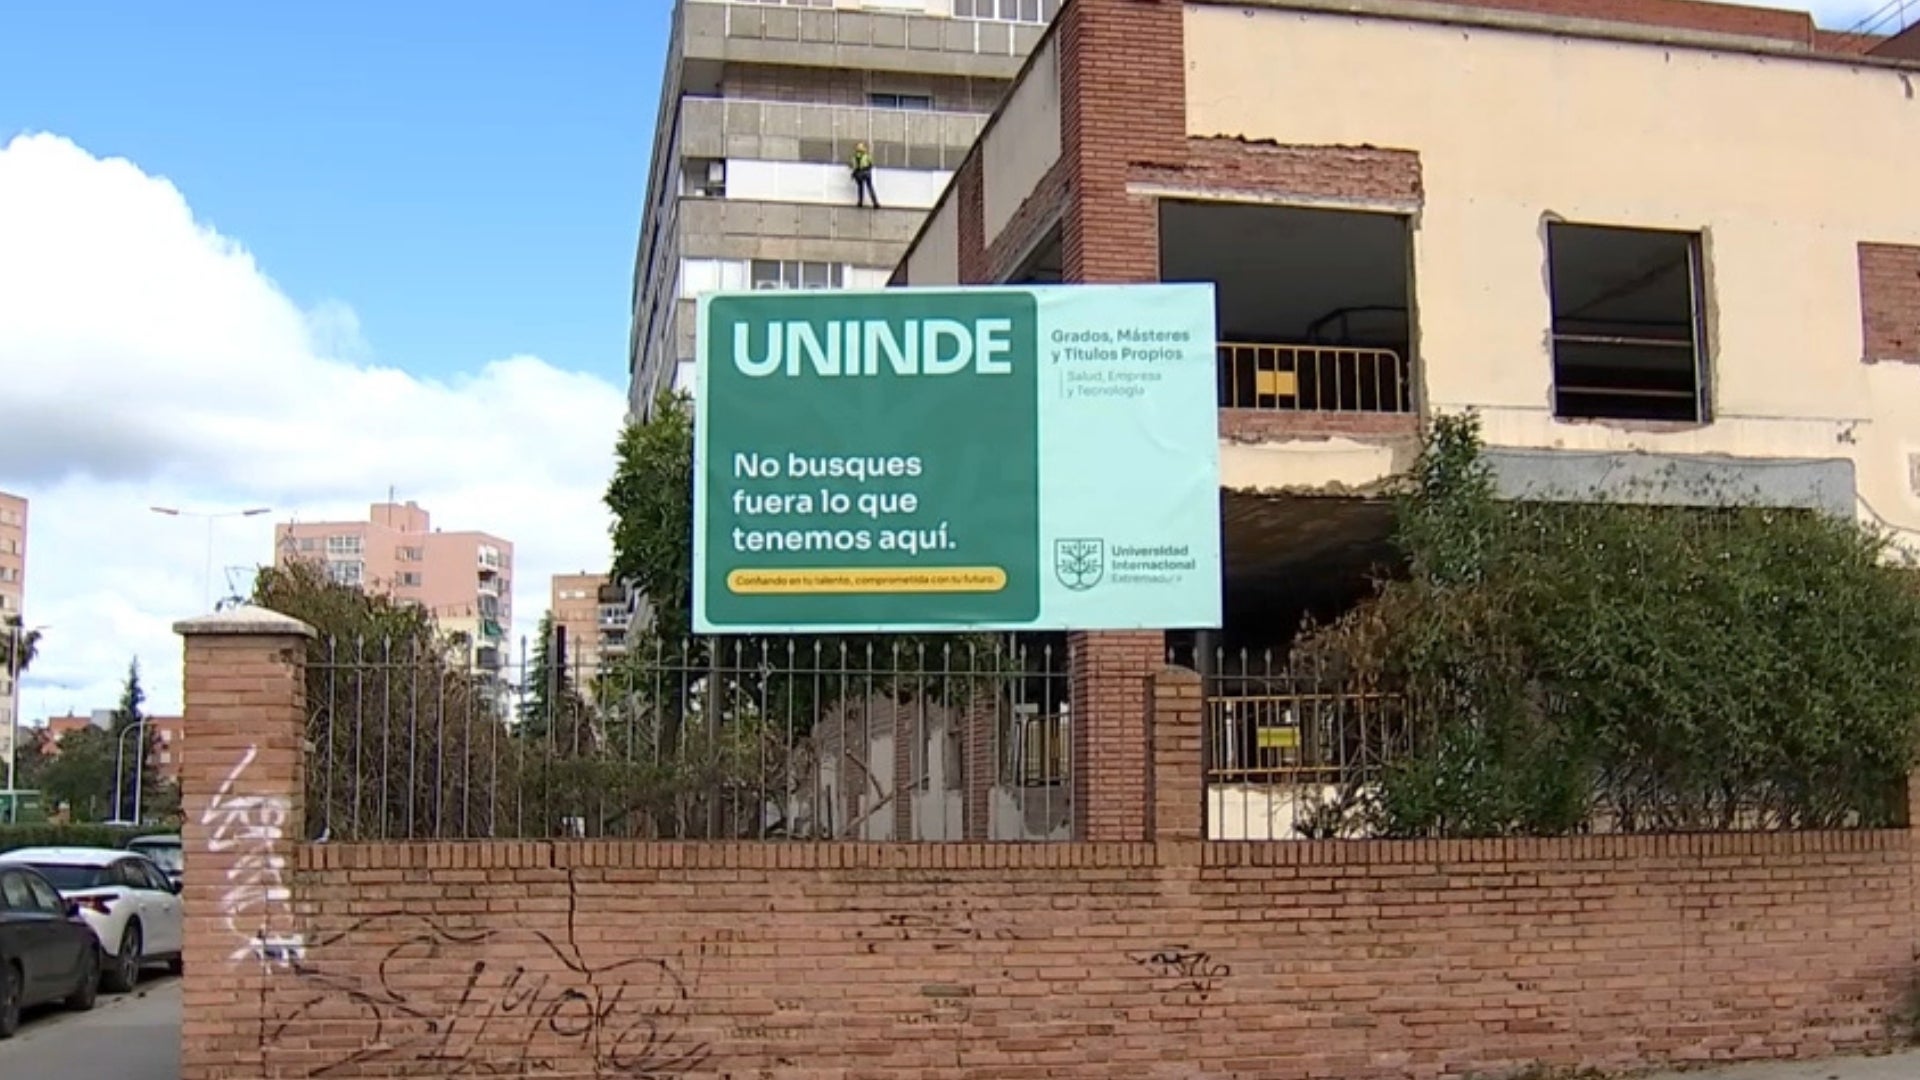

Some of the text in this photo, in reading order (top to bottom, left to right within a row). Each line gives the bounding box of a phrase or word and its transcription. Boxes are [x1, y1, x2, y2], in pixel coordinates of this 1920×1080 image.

[1052, 327, 1190, 344] Grados, Másteres
[734, 319, 1012, 376] UNINDE
[1052, 351, 1060, 363] y
[1121, 347, 1183, 362] Propios
[1067, 371, 1162, 383] Salud, Empresa
[1067, 387, 1074, 398] y
[734, 452, 922, 482] No busques
[733, 489, 918, 519] fuera lo que
[732, 521, 957, 554] tenemos aquí.
[1112, 545, 1189, 557] Universidad
[1112, 559, 1196, 570] Internacional
[736, 576, 787, 586] Confiando
[788, 577, 801, 586] en
[855, 574, 929, 586] comprometida
[930, 575, 949, 584] con
